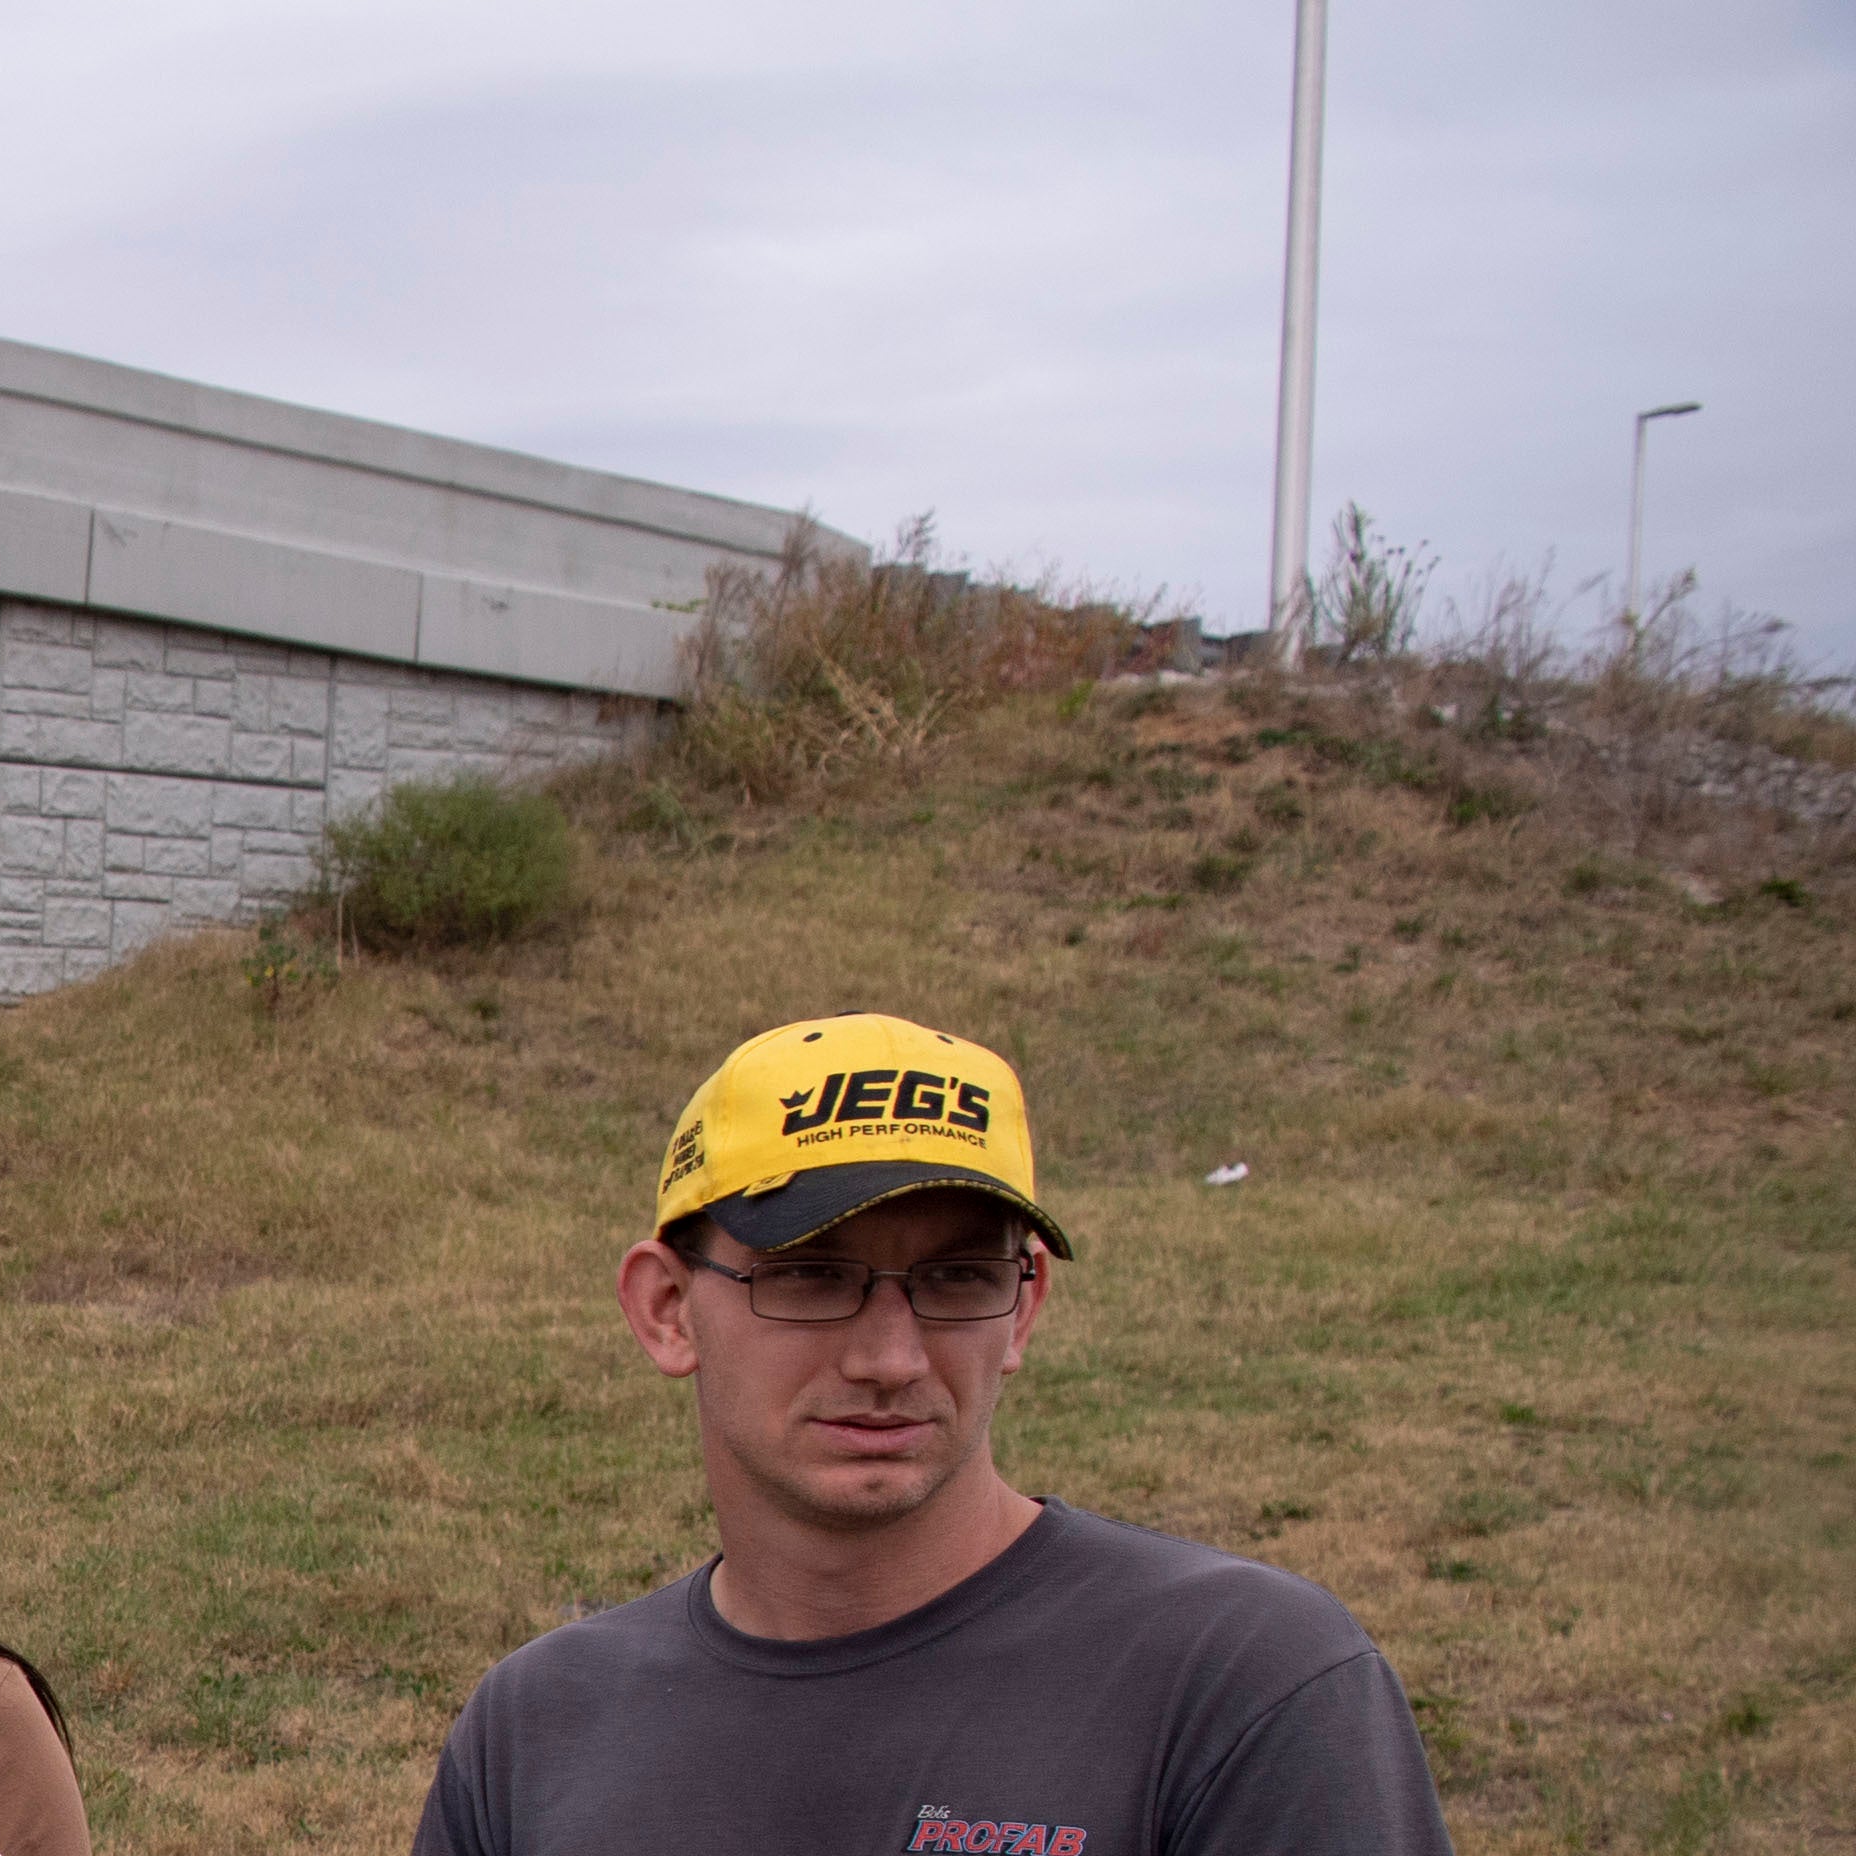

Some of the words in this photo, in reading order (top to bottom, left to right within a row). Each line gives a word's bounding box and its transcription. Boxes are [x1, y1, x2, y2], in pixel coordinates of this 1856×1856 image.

[782, 1069, 990, 1136] JEG'S
[797, 1127, 843, 1148] HIGH
[849, 1122, 988, 1150] PERFORMANCE
